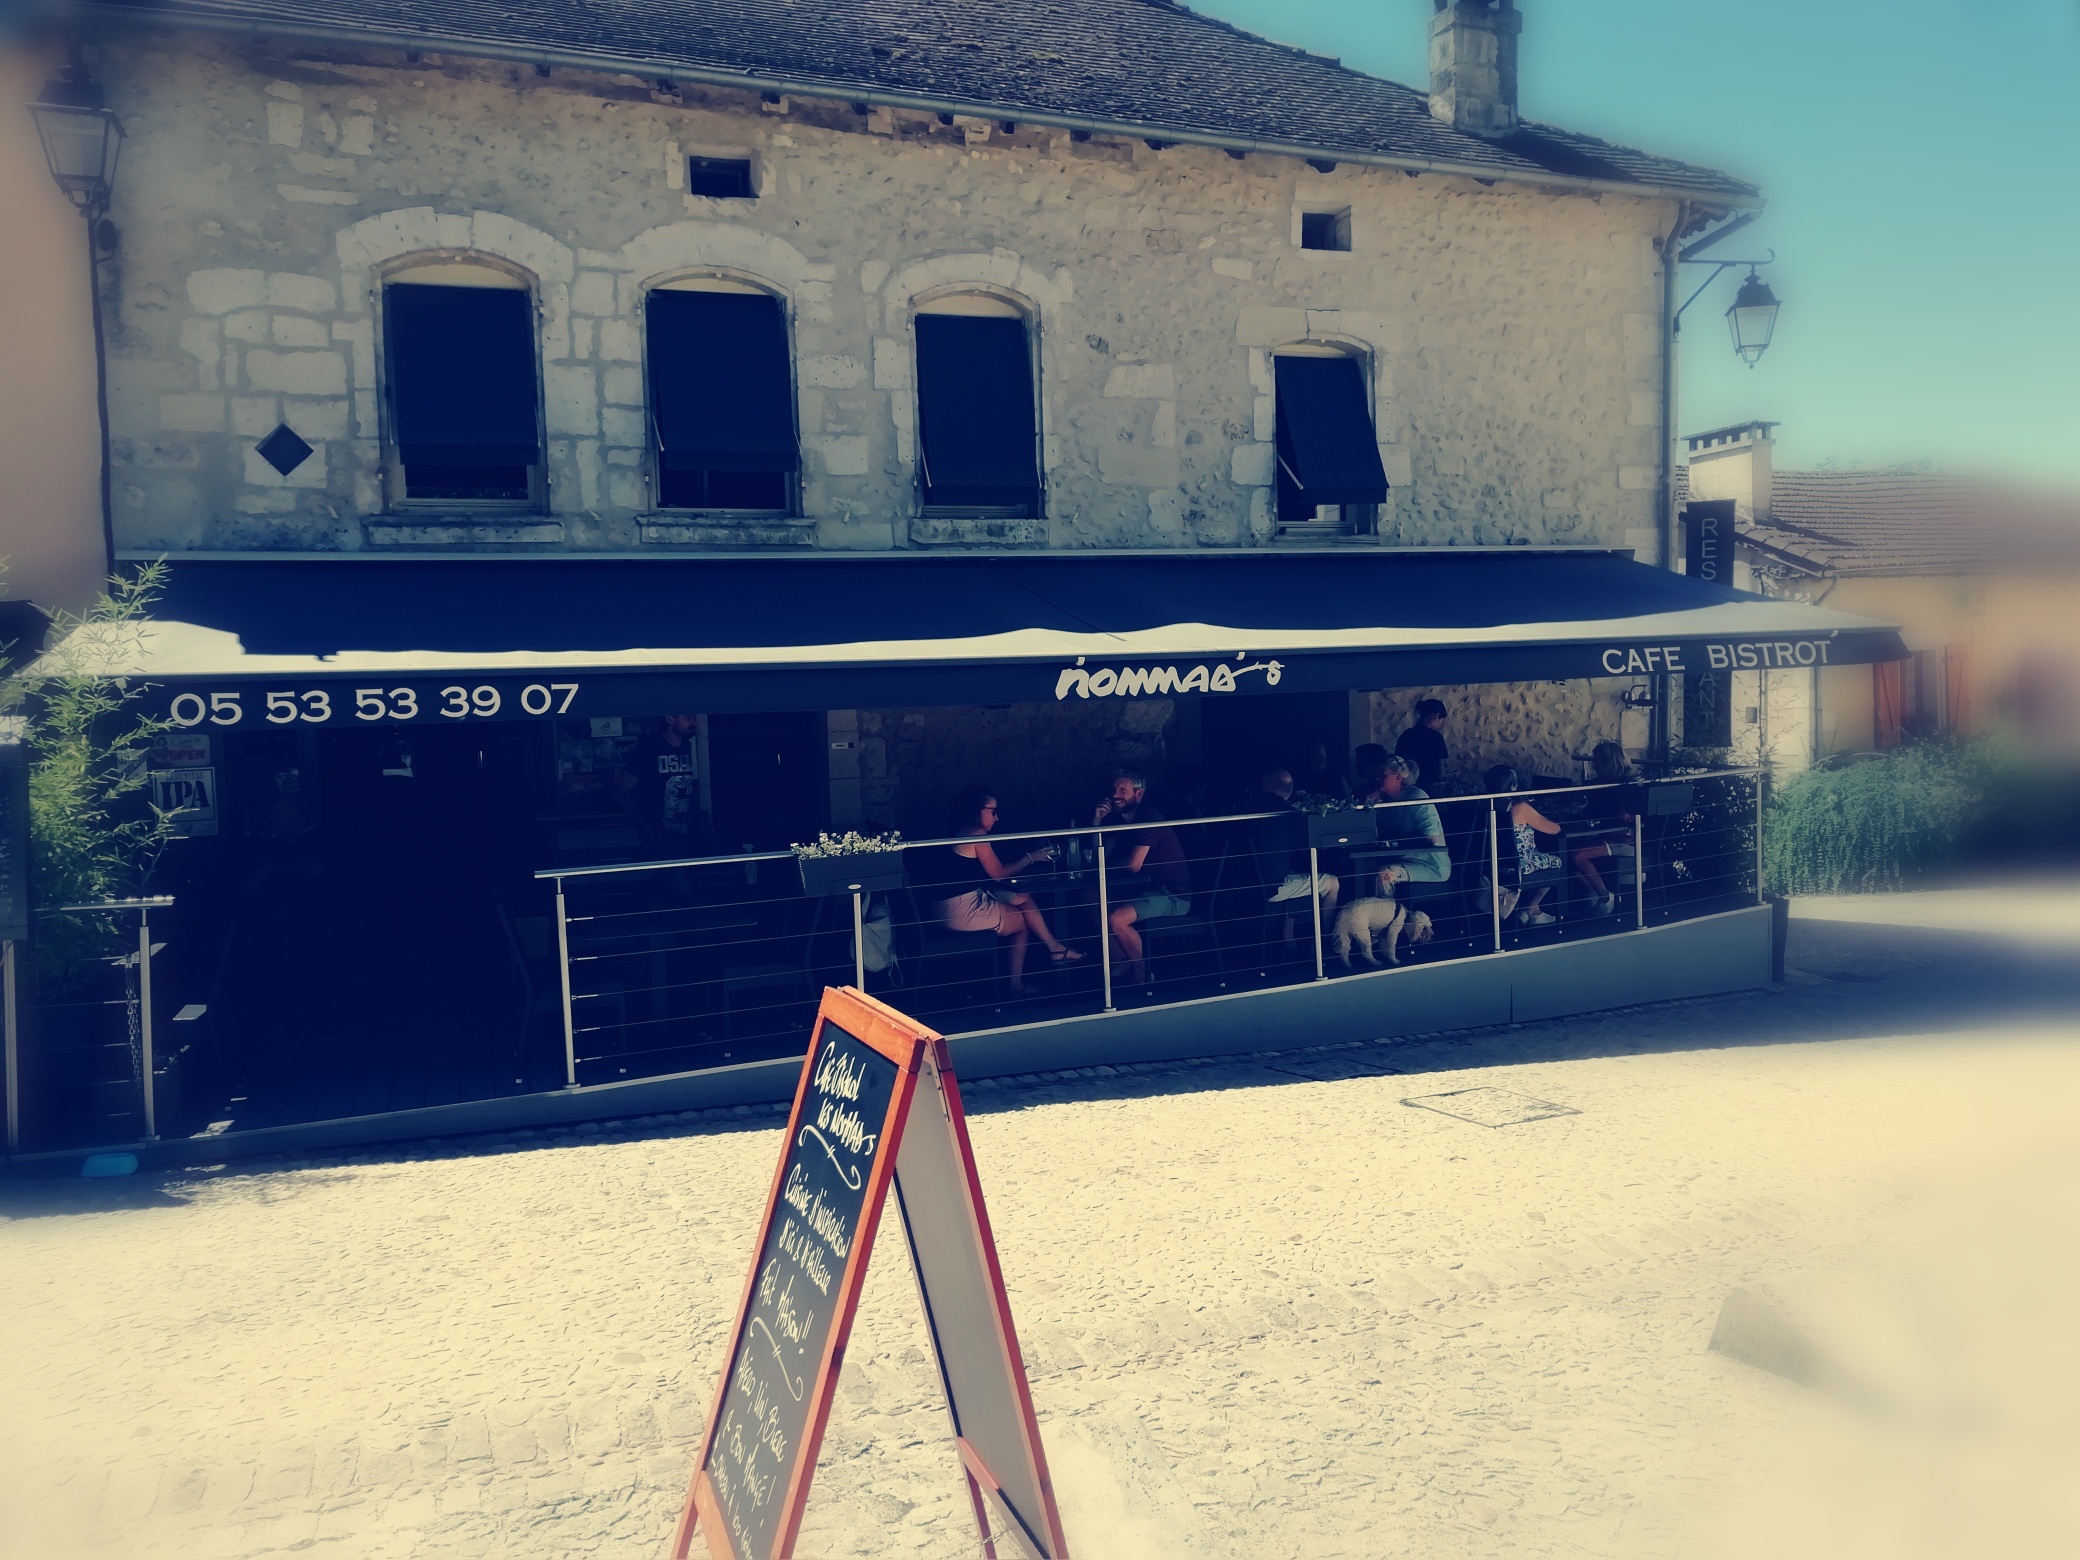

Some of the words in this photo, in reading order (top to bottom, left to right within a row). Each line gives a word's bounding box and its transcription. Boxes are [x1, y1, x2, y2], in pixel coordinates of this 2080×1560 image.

[1602, 646, 1686, 674] CAFE
[1706, 640, 1831, 669] BISTROT
[170, 693, 243, 726] 05
[265, 690, 332, 724] 53
[355, 687, 419, 721] 53
[440, 685, 501, 718] 39
[520, 683, 579, 715] 07
[170, 749, 206, 761] OPEN
[160, 780, 211, 810] IPA
